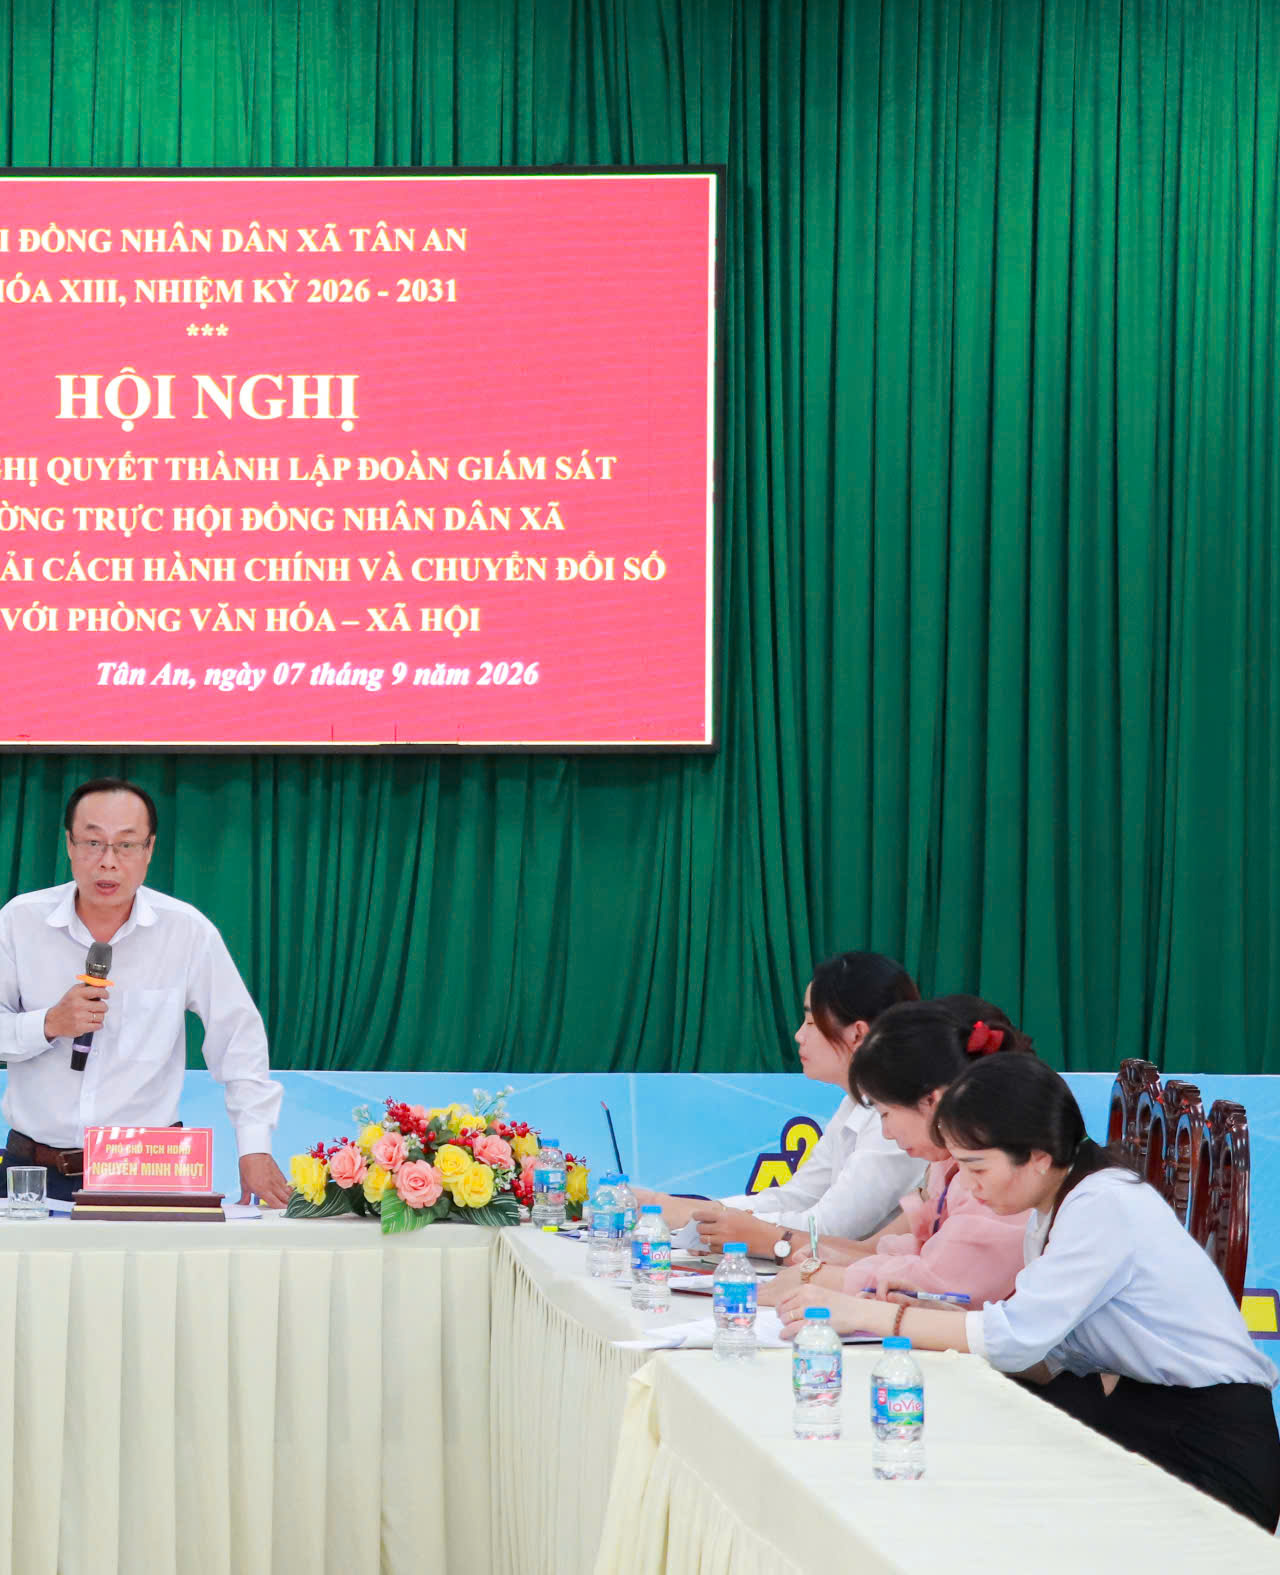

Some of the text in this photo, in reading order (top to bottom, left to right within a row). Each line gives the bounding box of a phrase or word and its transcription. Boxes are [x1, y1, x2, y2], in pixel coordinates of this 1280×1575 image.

[17, 221, 113, 254] ĐỒNG
[119, 220, 213, 253] NHÂN
[220, 220, 289, 253] DÂN
[295, 222, 343, 253] XÃ
[348, 219, 416, 252] TÂN
[421, 227, 468, 252] AN
[58, 278, 128, 308] XIII,
[133, 275, 244, 310] NHIỆM
[251, 271, 300, 304] KỲ
[306, 278, 371, 304] 2026
[396, 277, 457, 303] 2031
[54, 366, 360, 433] HỘI NGHỊ
[46, 450, 160, 487] QUYẾT
[164, 449, 280, 481] THÀNH
[288, 453, 352, 488] LẬP
[356, 449, 450, 482] ĐOÀN
[457, 449, 547, 481] GIÁM
[555, 448, 618, 481] SÁT
[72, 503, 164, 538] TRỰC
[171, 503, 233, 538] HỘI
[239, 500, 336, 532] ĐỒNG
[342, 499, 436, 532] NHÂN
[442, 498, 512, 531] DÂN
[519, 500, 566, 531] XÃ
[41, 550, 135, 582] CÁCH
[141, 550, 237, 582] HÀNH
[243, 550, 351, 582] CHÍNH
[357, 550, 404, 582] VÀ
[411, 550, 548, 582] CHUYỂN
[555, 550, 616, 582] ĐỔI
[623, 549, 667, 581] SỐ
[0, 600, 59, 632] VỚI
[66, 600, 182, 633] PHÒNG
[189, 602, 257, 632] VĂN
[264, 600, 337, 633] HÓA
[365, 602, 413, 632] XÃ
[419, 604, 481, 639] HỘI
[96, 660, 540, 692] Tân An, ngày 07 tháng 9 năm 2026
[141, 1162, 171, 1176] MINH
